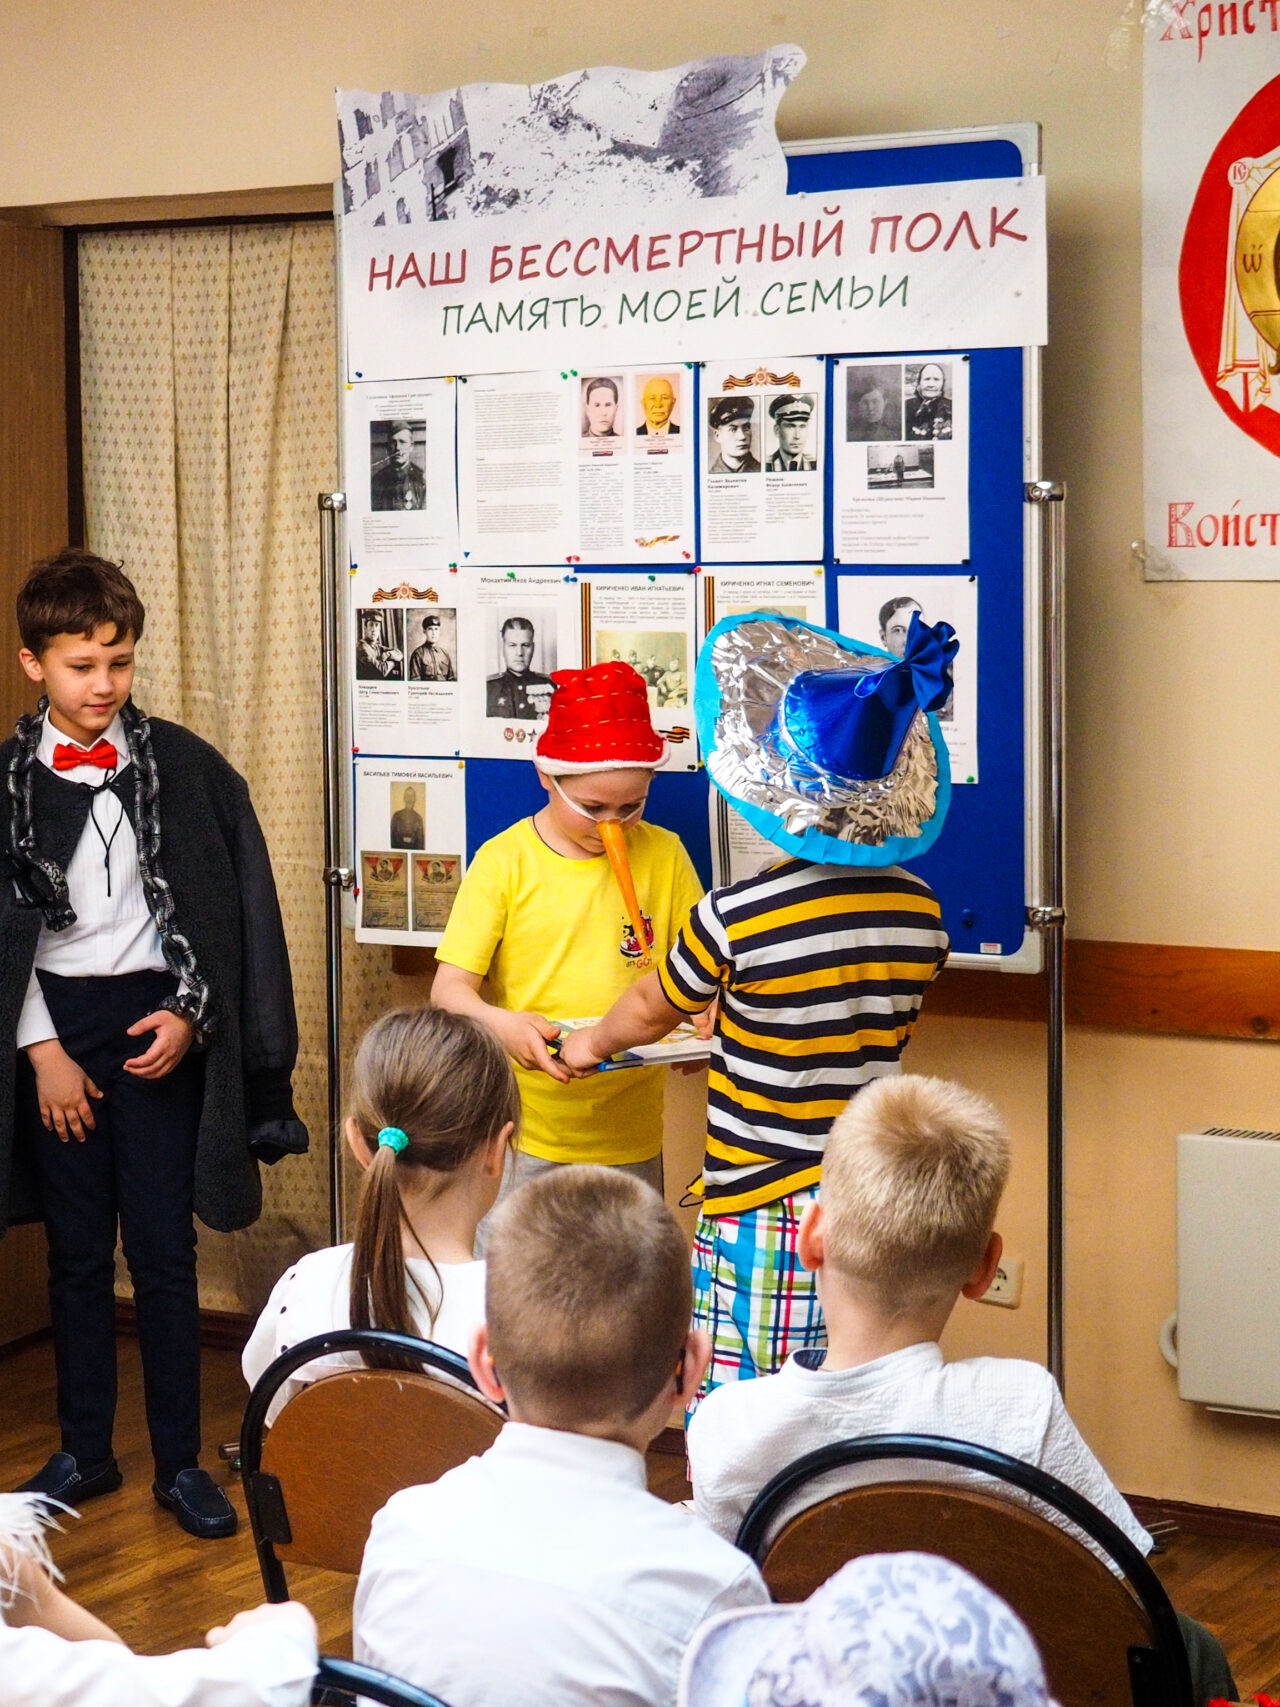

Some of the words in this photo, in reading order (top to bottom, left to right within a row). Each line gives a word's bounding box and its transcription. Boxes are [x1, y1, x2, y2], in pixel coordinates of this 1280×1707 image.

[368, 248, 466, 292] НАШ
[489, 205, 843, 284] БЕССМЕРТНЫЙ
[869, 206, 1027, 255] ПОЛК
[442, 294, 602, 336] ПАМЯТЬ
[618, 275, 740, 325] МОЕЙ
[760, 274, 909, 316] СЕМЬИ
